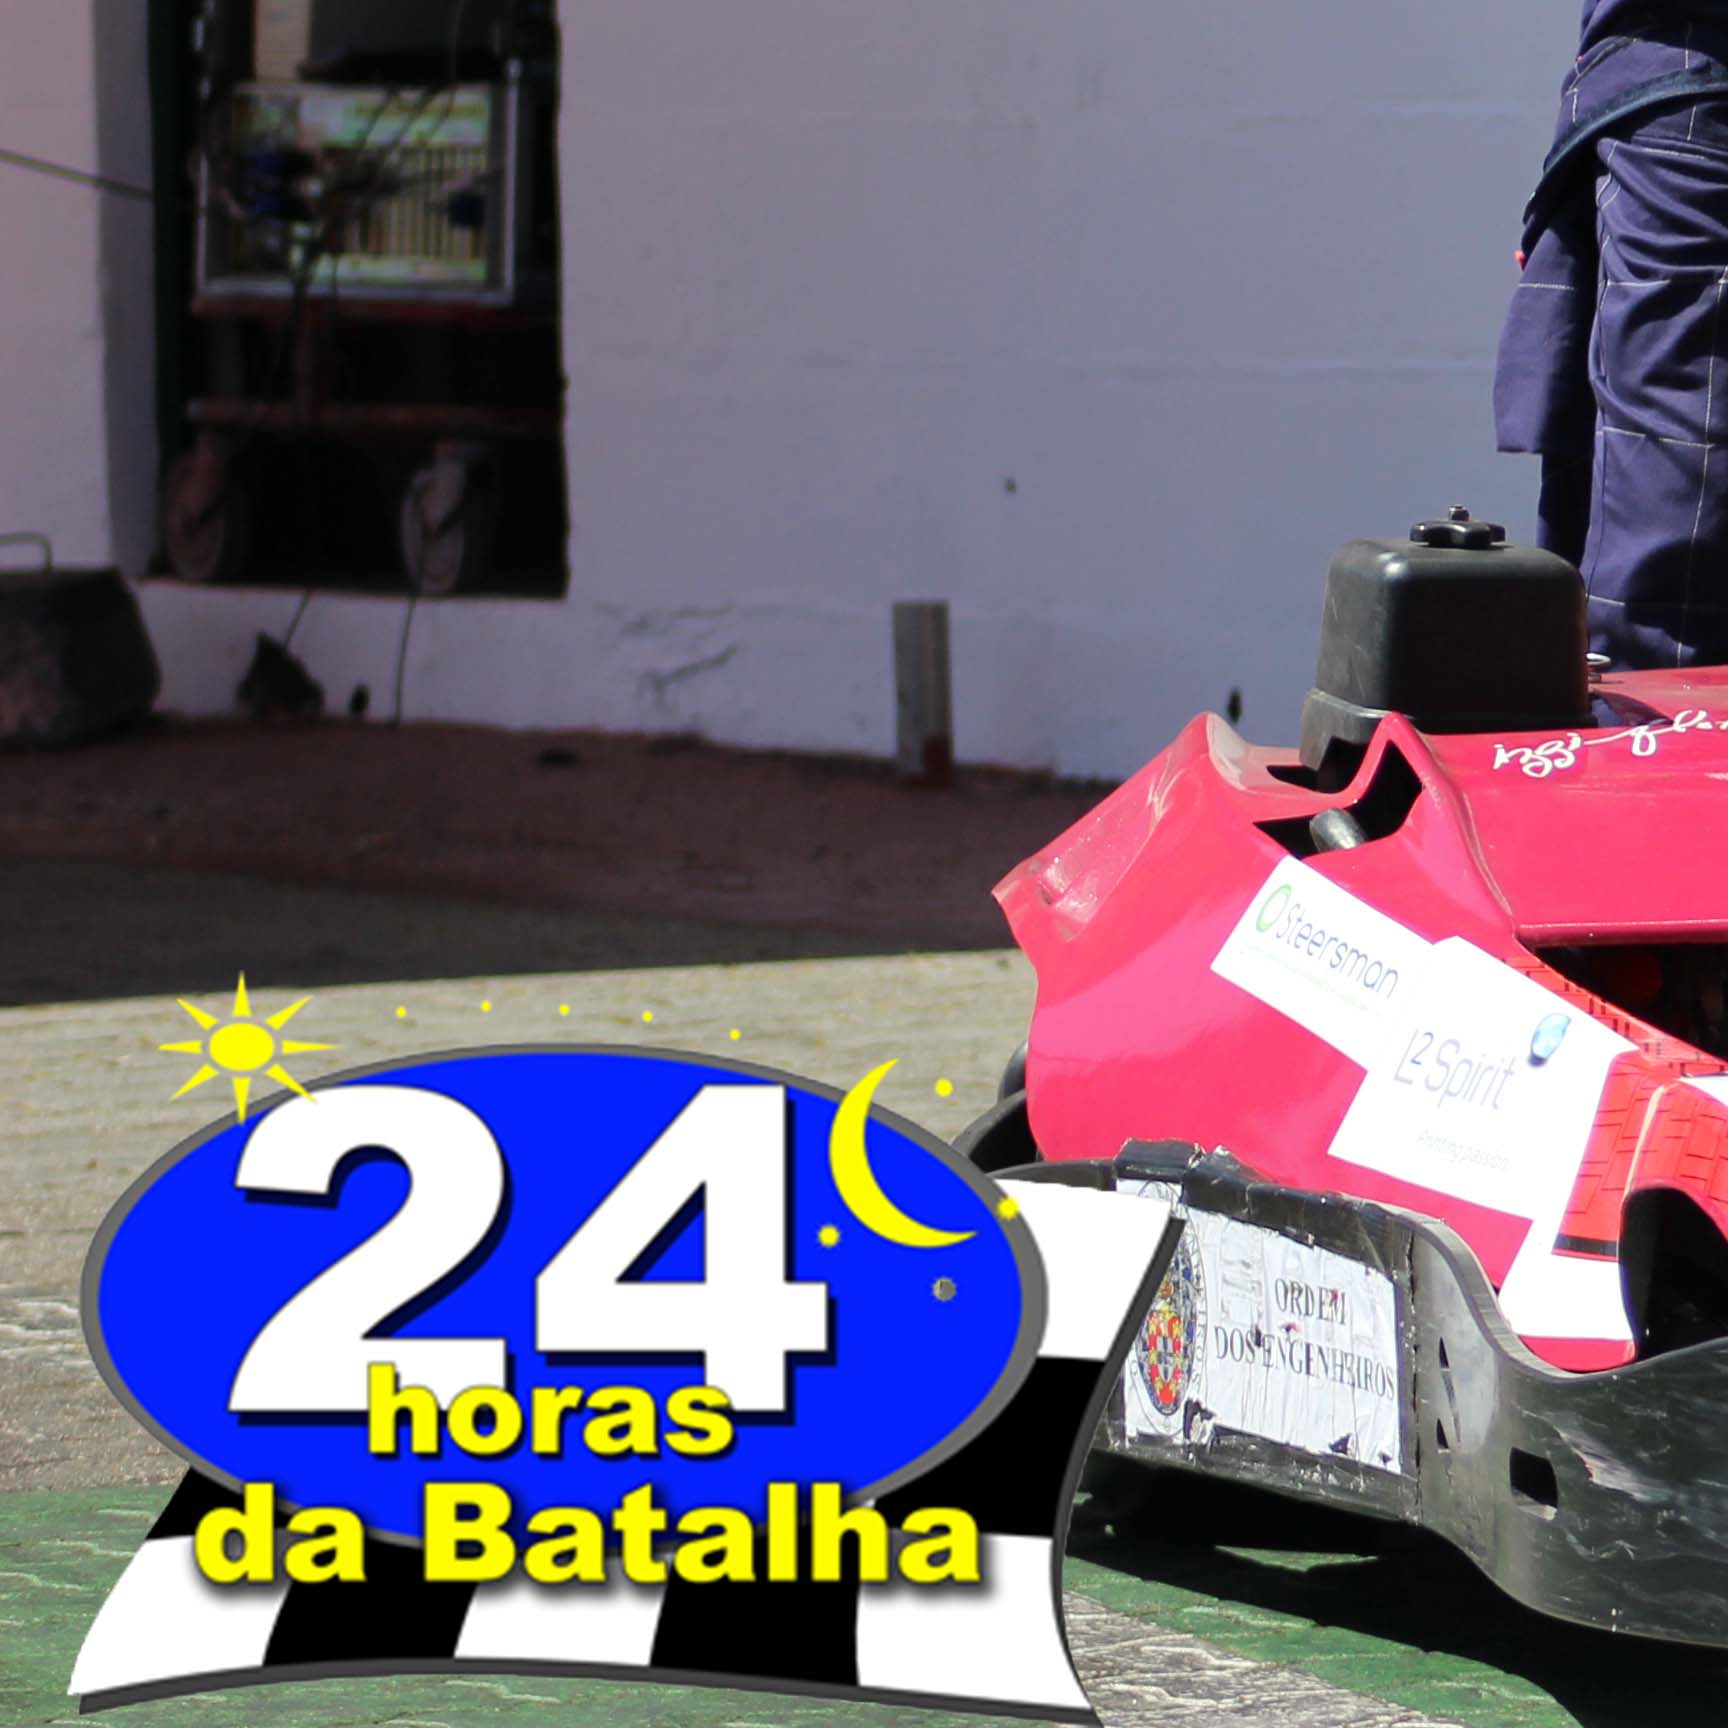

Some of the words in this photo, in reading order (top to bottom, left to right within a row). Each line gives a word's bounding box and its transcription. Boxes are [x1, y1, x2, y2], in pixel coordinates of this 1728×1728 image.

[1275, 902, 1399, 1000] steersman
[1275, 1278, 1347, 1326] ORDEM
[1215, 1325, 1256, 1365] DOS
[1262, 1334, 1396, 1402] ENGENHEIROS
